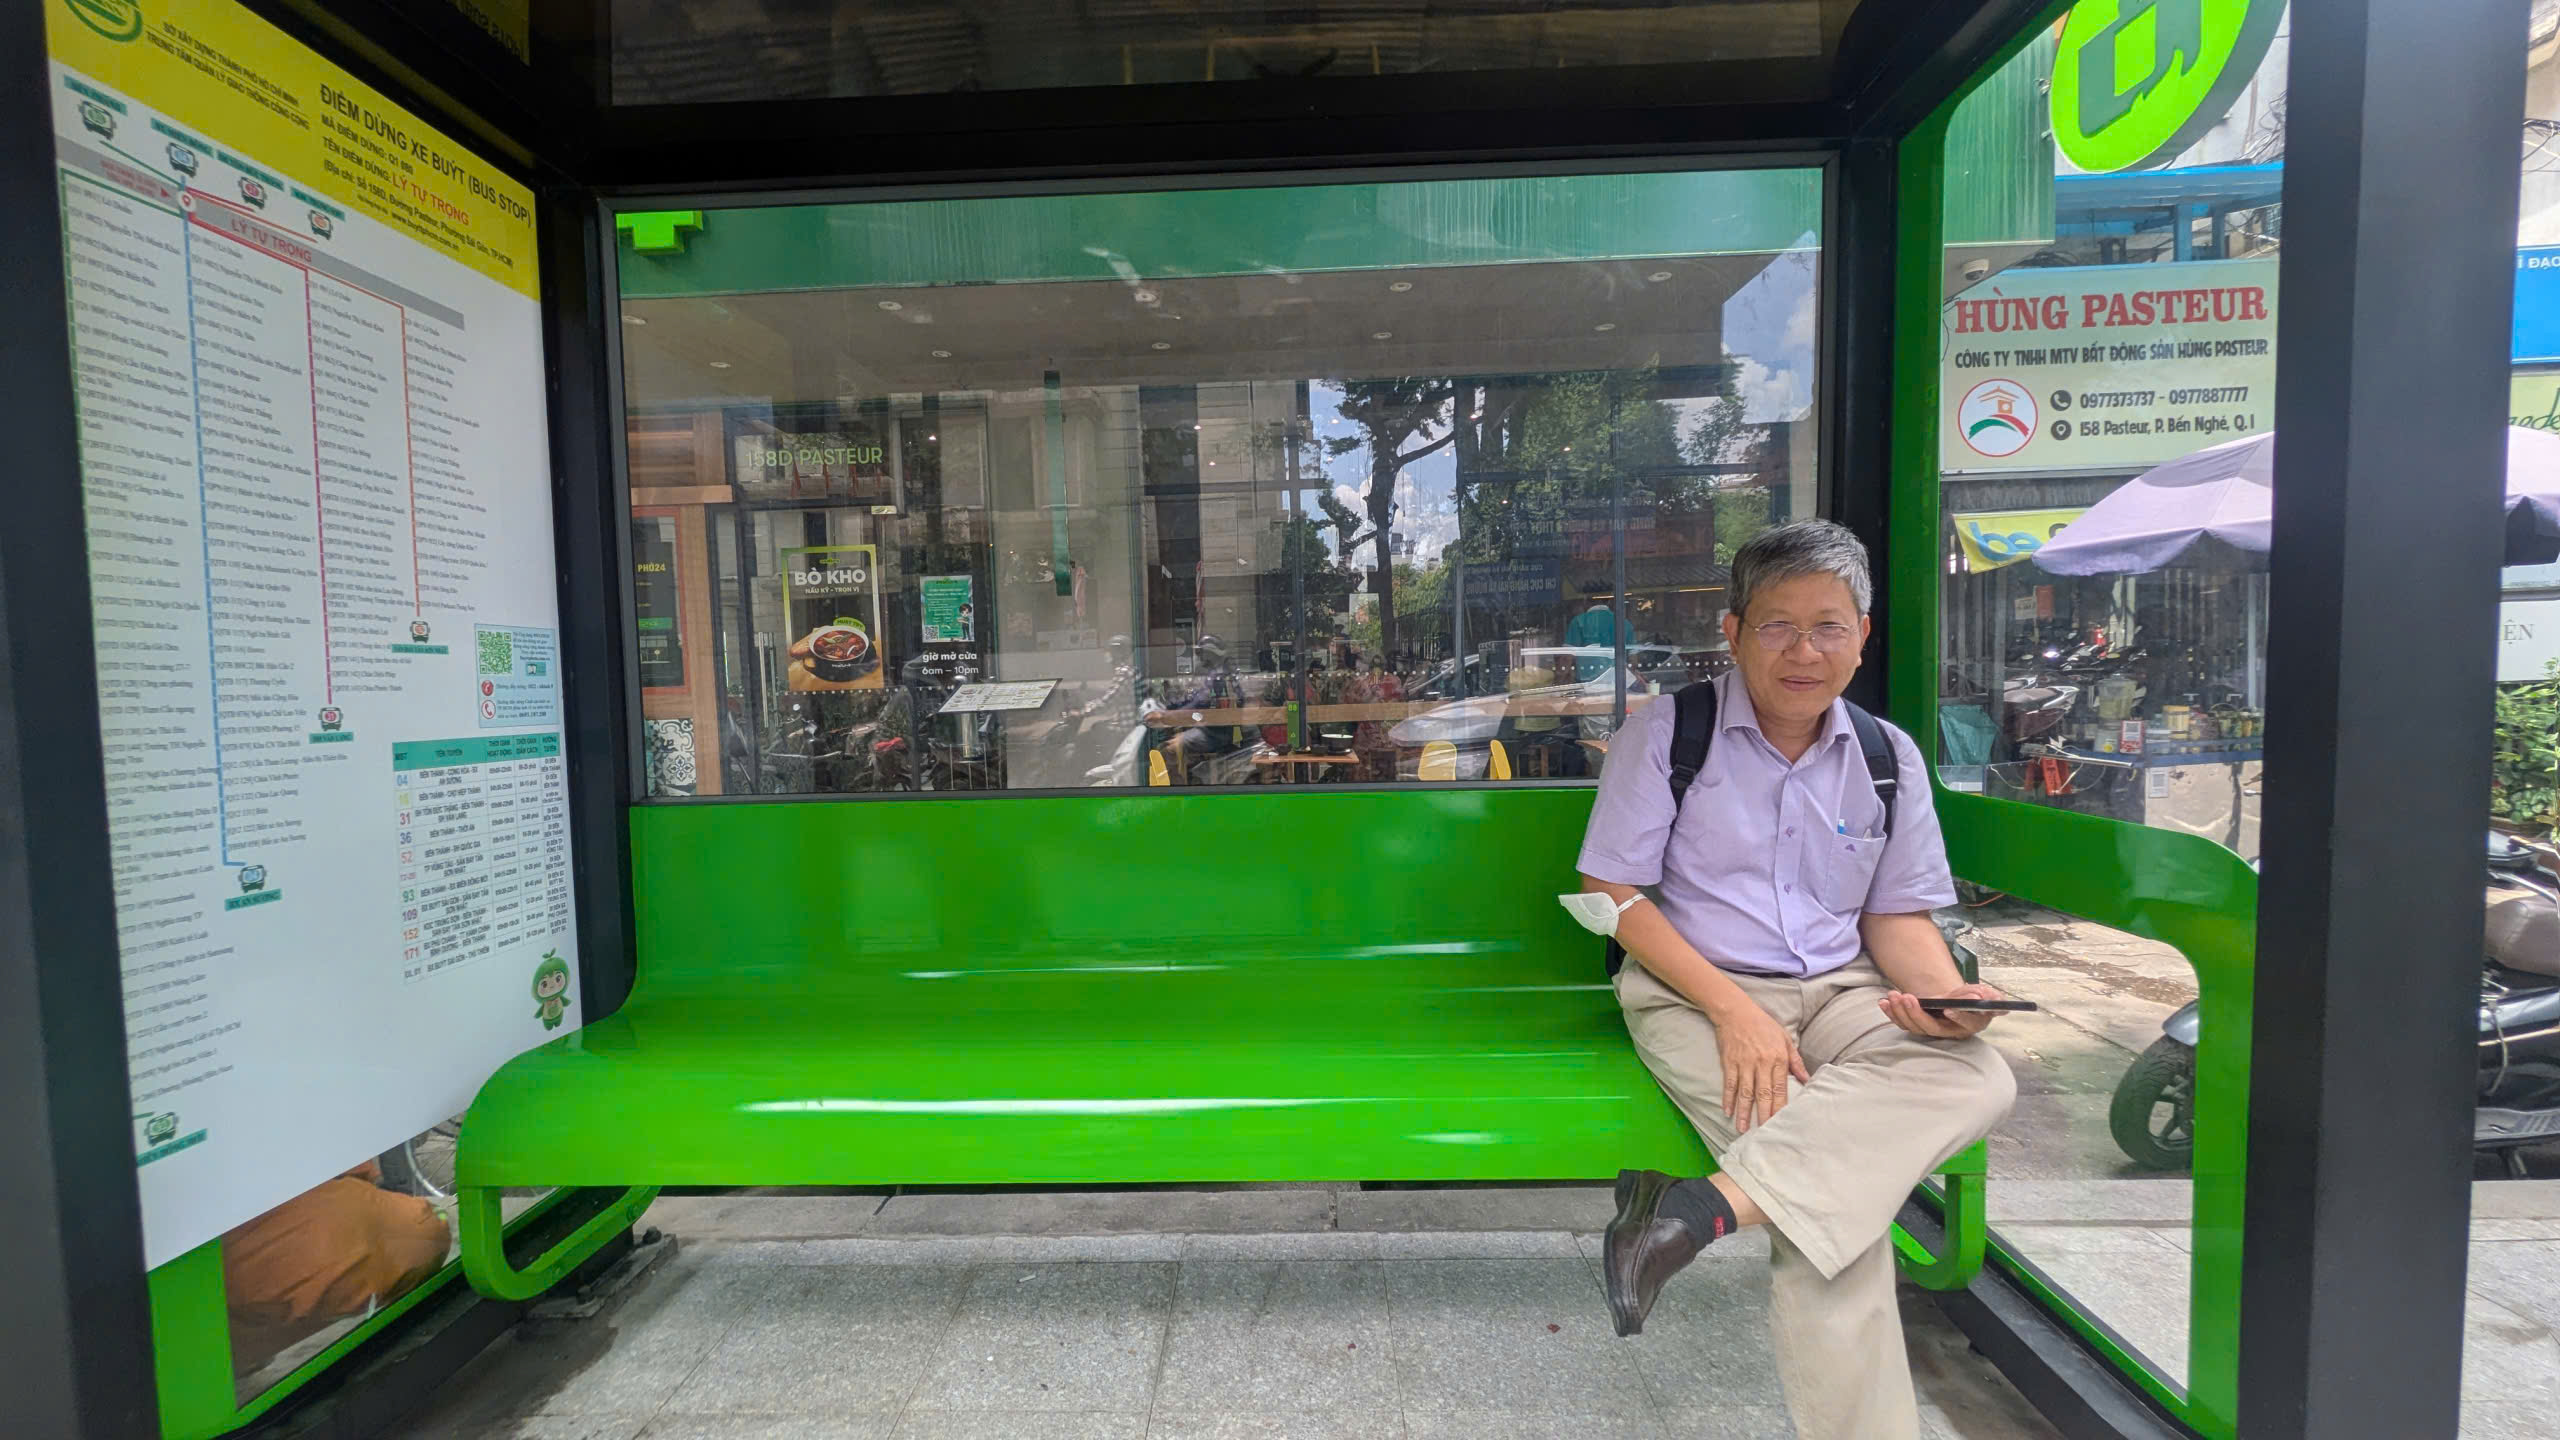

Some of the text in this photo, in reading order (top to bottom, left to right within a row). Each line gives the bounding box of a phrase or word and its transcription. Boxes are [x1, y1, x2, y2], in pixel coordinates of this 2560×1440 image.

[320, 82, 531, 229] ĐIỂM DỪNG XE BUÝT (BUS STOP)
[392, 170, 408, 191] LÝ
[411, 182, 428, 205] TỰ
[430, 193, 469, 225] TRỌNG
[1954, 286, 2268, 333] HÙNG PASTEUR
[1955, 348, 1991, 368] CÔNG
[1993, 350, 2010, 367] TY
[2014, 348, 2046, 366] TNHH
[2050, 347, 2079, 364] MTV
[2082, 340, 2106, 363] BẤT
[2110, 343, 2146, 365] ĐỘNG
[2215, 338, 2268, 356] PASTEUR
[2080, 390, 2155, 409] 0977373737
[2169, 386, 2249, 405] 0977887777
[2080, 421, 2100, 437] 158
[2104, 419, 2151, 437] Pasteur,
[2155, 417, 2165, 433] P.
[2167, 415, 2191, 432] Bến
[2234, 415, 2249, 431] Q.
[746, 447, 883, 467] 158D PASTEUR
[1968, 521, 2043, 562] be
[794, 567, 866, 585] BÒ KHO
[2504, 619, 2536, 645] ỆN
[922, 650, 977, 663] giờ mở cửa
[922, 667, 943, 675] 6am
[954, 666, 979, 677] 10pm
[400, 812, 410, 825] 31
[400, 832, 412, 845] 36
[402, 889, 415, 903] 93
[402, 908, 418, 921] 109
